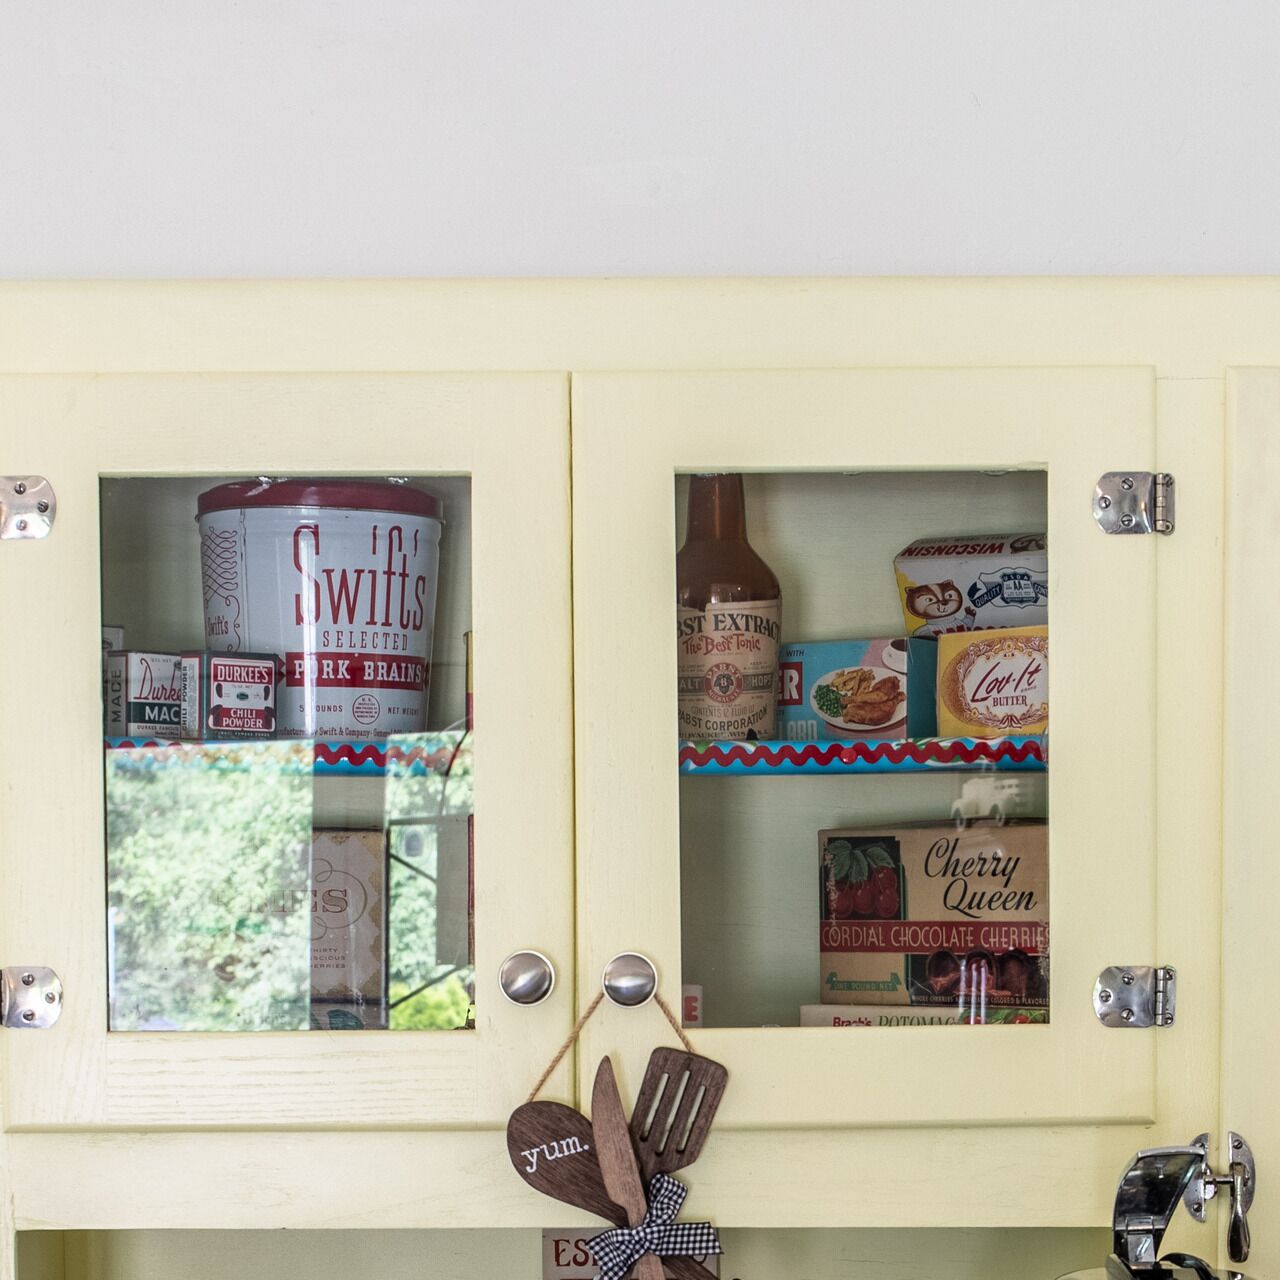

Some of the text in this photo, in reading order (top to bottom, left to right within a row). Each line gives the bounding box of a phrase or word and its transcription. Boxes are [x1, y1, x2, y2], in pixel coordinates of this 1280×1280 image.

[293, 524, 426, 631] Swift's
[975, 585, 1002, 607] QUALITY
[322, 630, 408, 651] SELECTED
[786, 649, 805, 657] WITH
[217, 665, 269, 683] DURKEE'S
[363, 660, 422, 684] BRAINS
[315, 704, 343, 713] OUNDS
[992, 694, 1028, 707] BUTTER
[222, 718, 263, 728] POWDER
[230, 708, 256, 718] CHILI
[924, 837, 1021, 888] Cherry
[942, 877, 1038, 919] Queen
[822, 926, 886, 948] CORDIAL
[890, 926, 975, 948] CHOCOLATE
[521, 1136, 590, 1173] yum.
